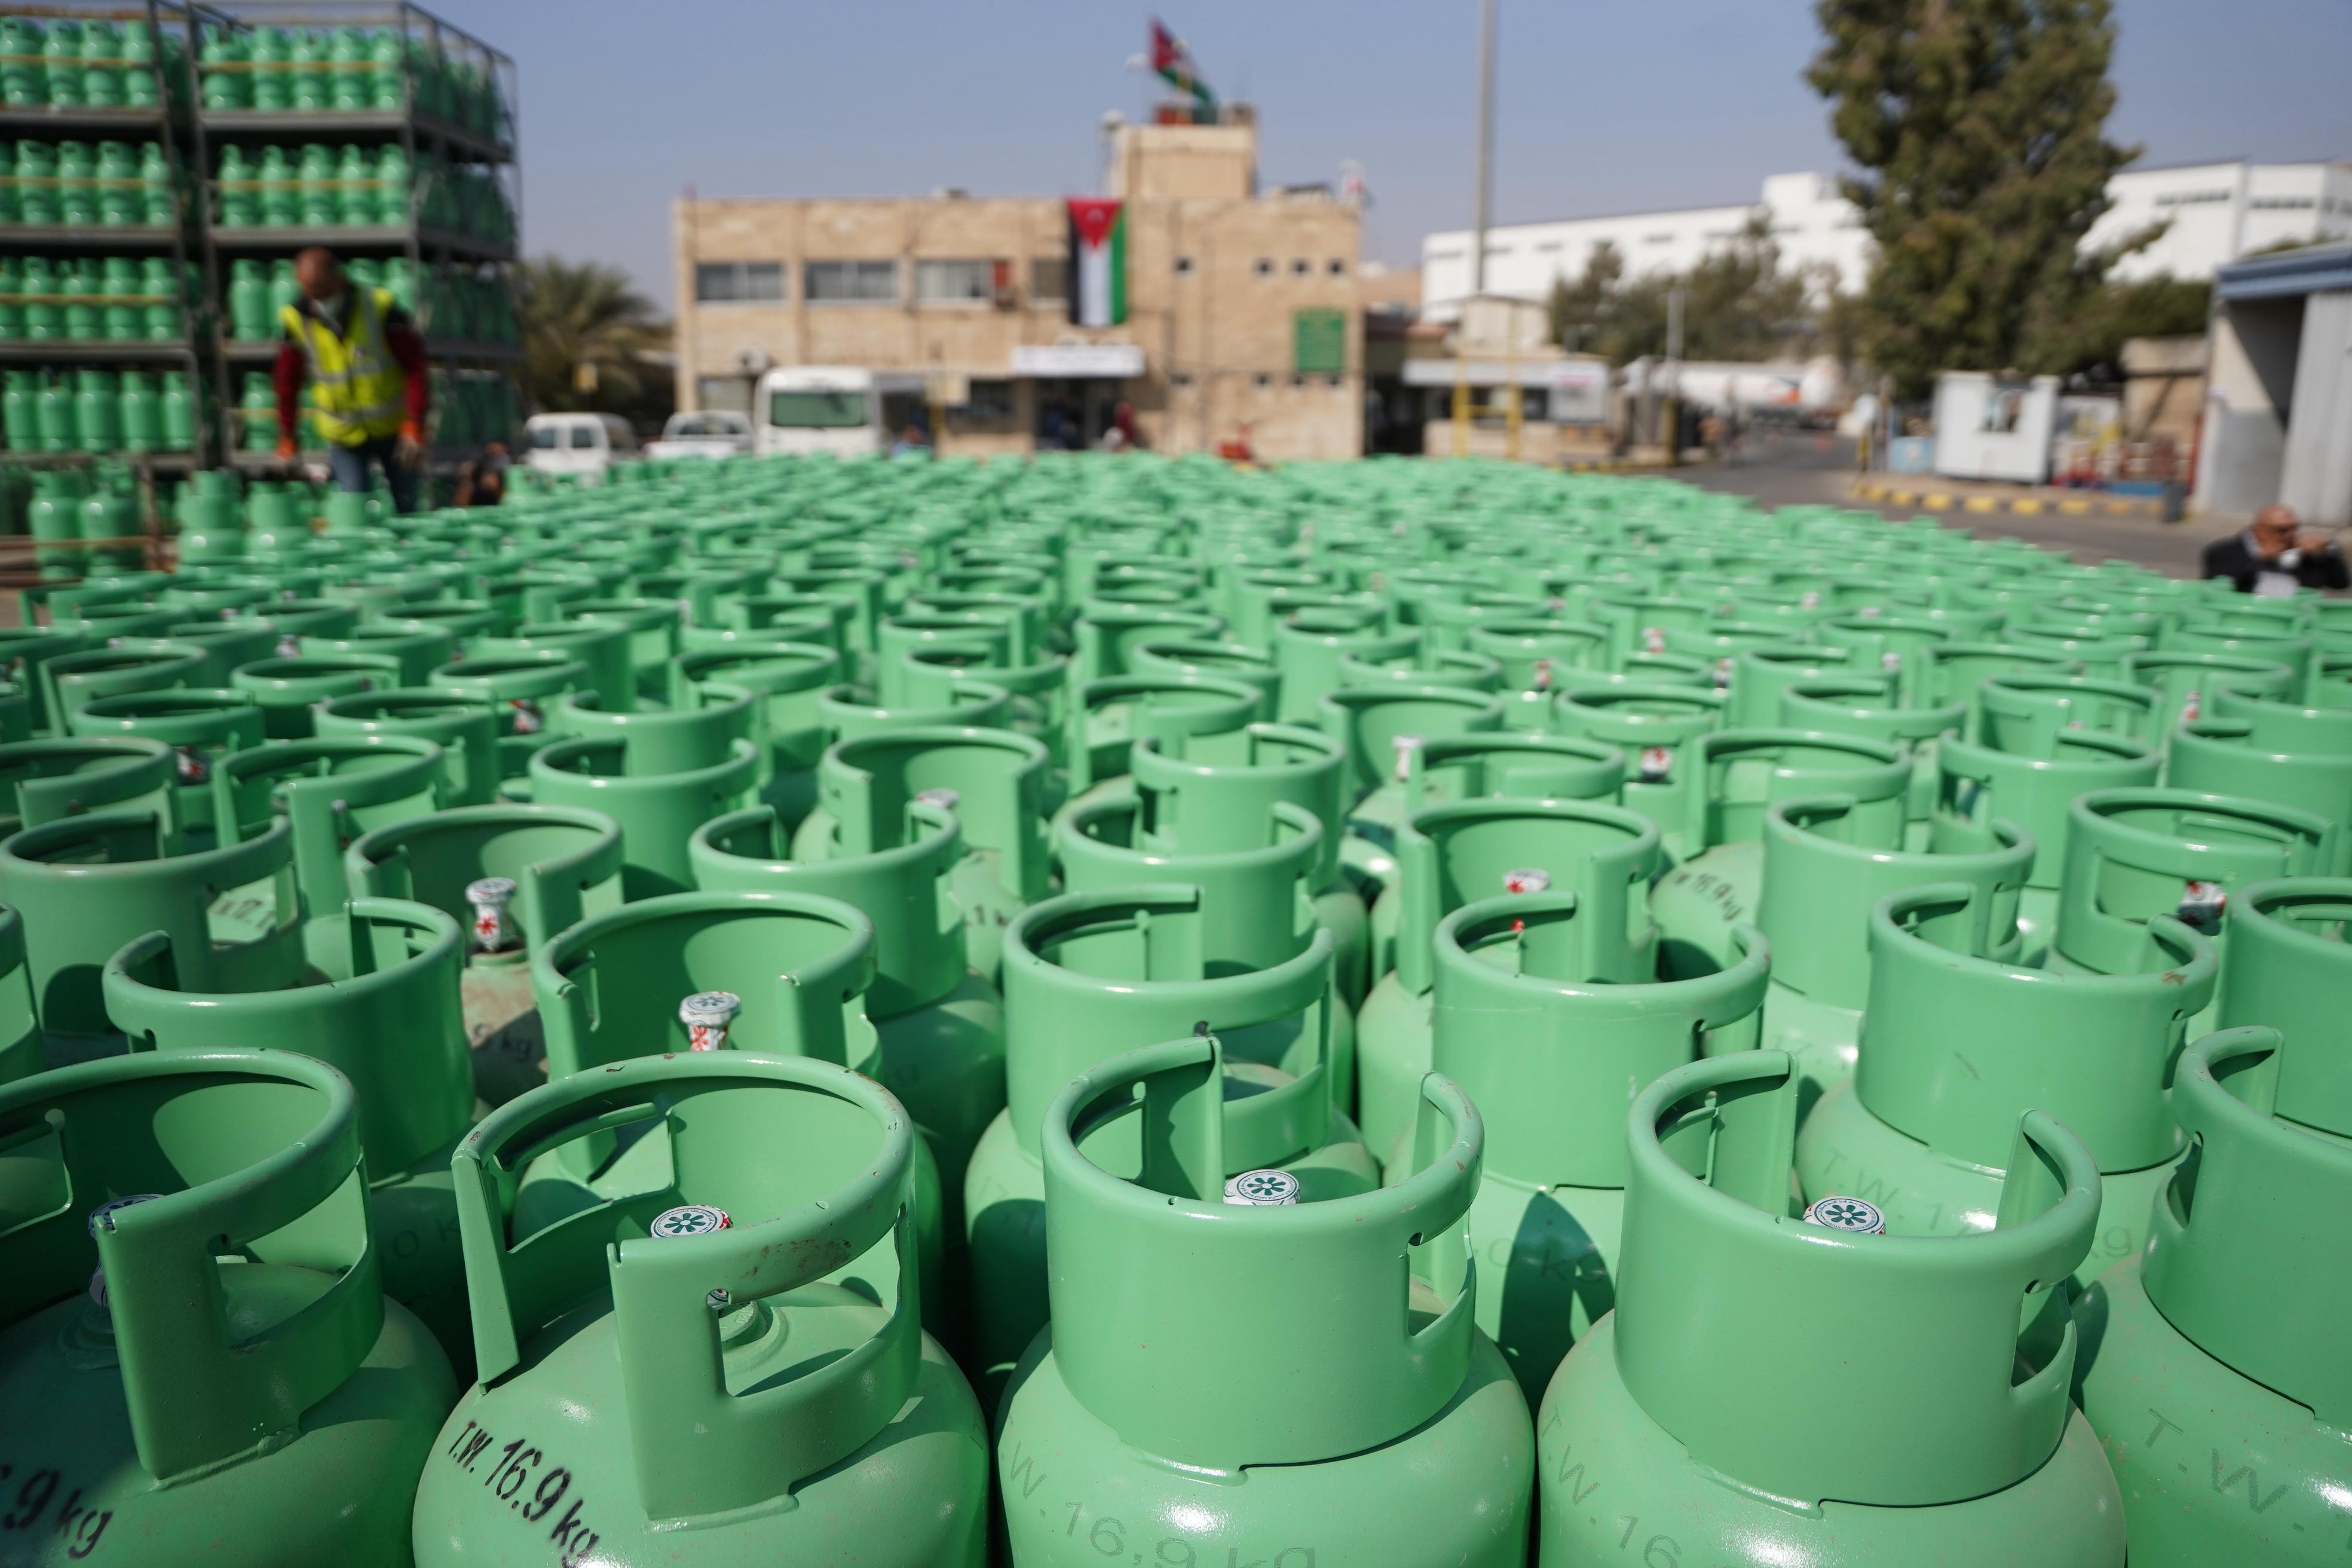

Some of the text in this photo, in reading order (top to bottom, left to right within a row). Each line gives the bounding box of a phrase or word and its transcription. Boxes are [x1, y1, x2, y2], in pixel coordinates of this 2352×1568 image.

[54, 1488, 113, 1560] kg
[448, 1420, 599, 1568] T.W. 16.9 kg
